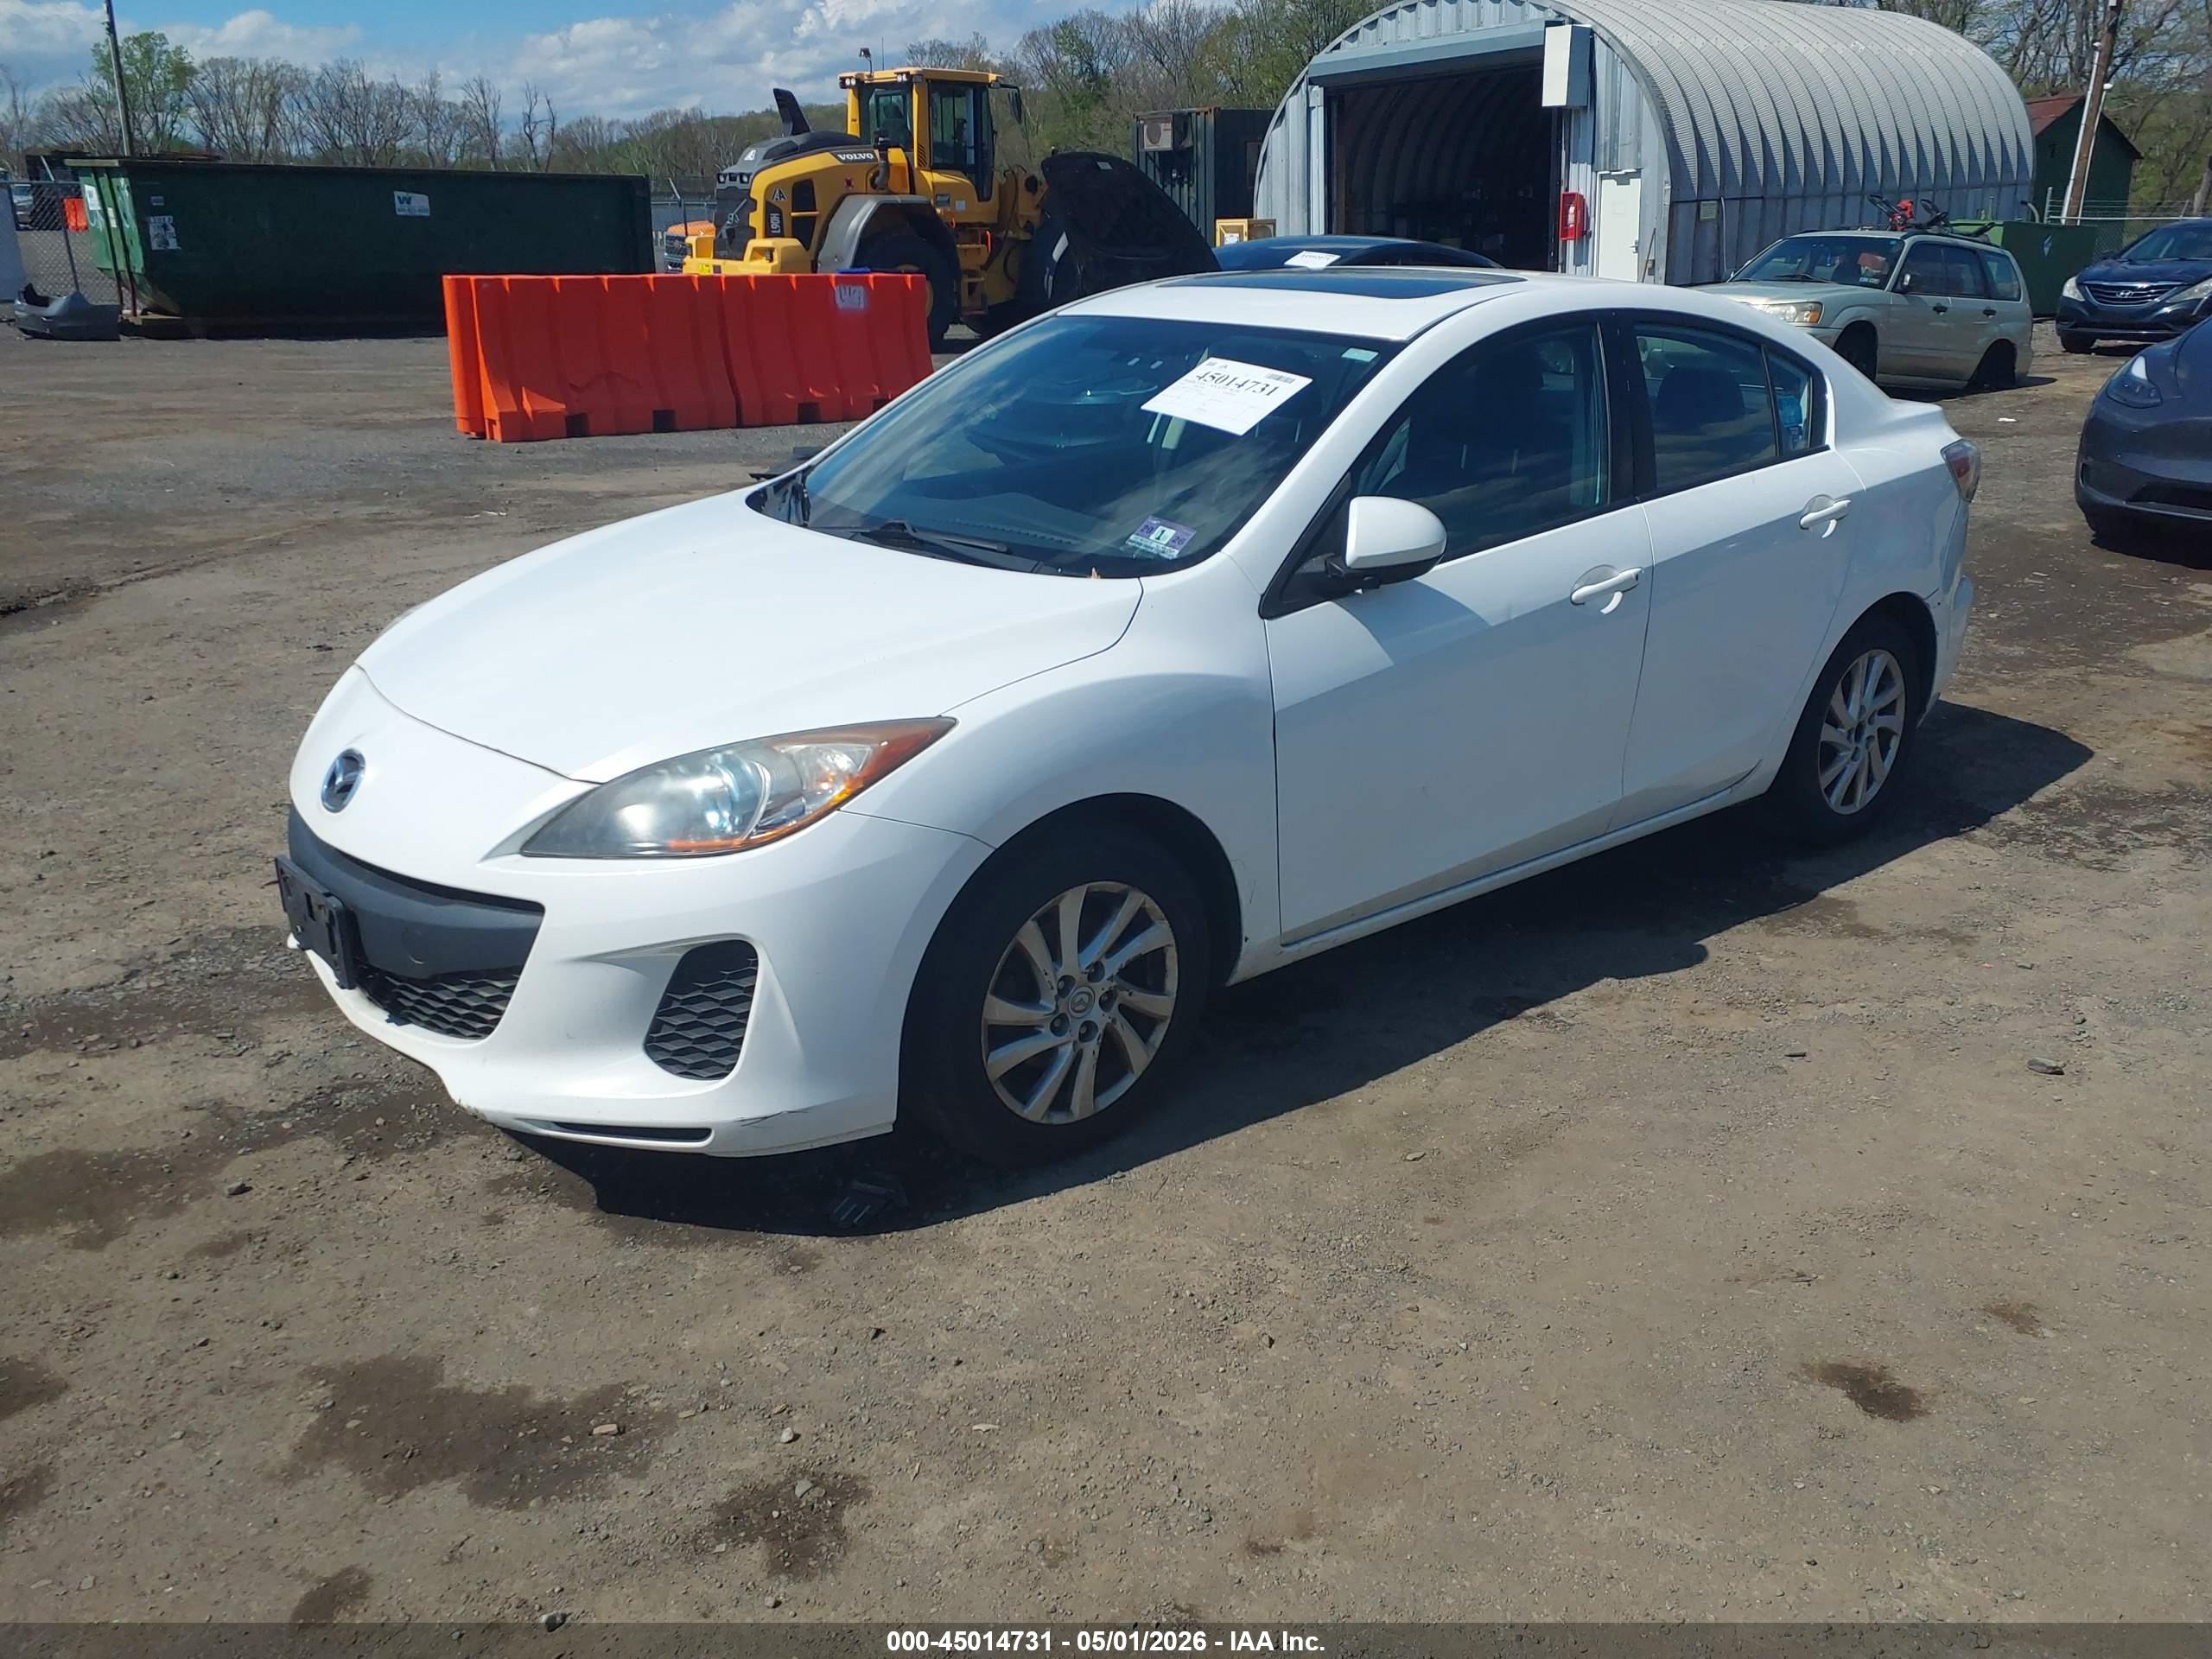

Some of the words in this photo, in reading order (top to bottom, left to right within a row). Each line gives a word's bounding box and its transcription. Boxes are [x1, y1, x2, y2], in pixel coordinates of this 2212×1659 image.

[837, 152, 874, 161] VOLVO
[770, 213, 781, 233] L90H
[1196, 371, 1279, 397] 45014731
[1141, 524, 1154, 534] 20
[1155, 529, 1166, 541] 1
